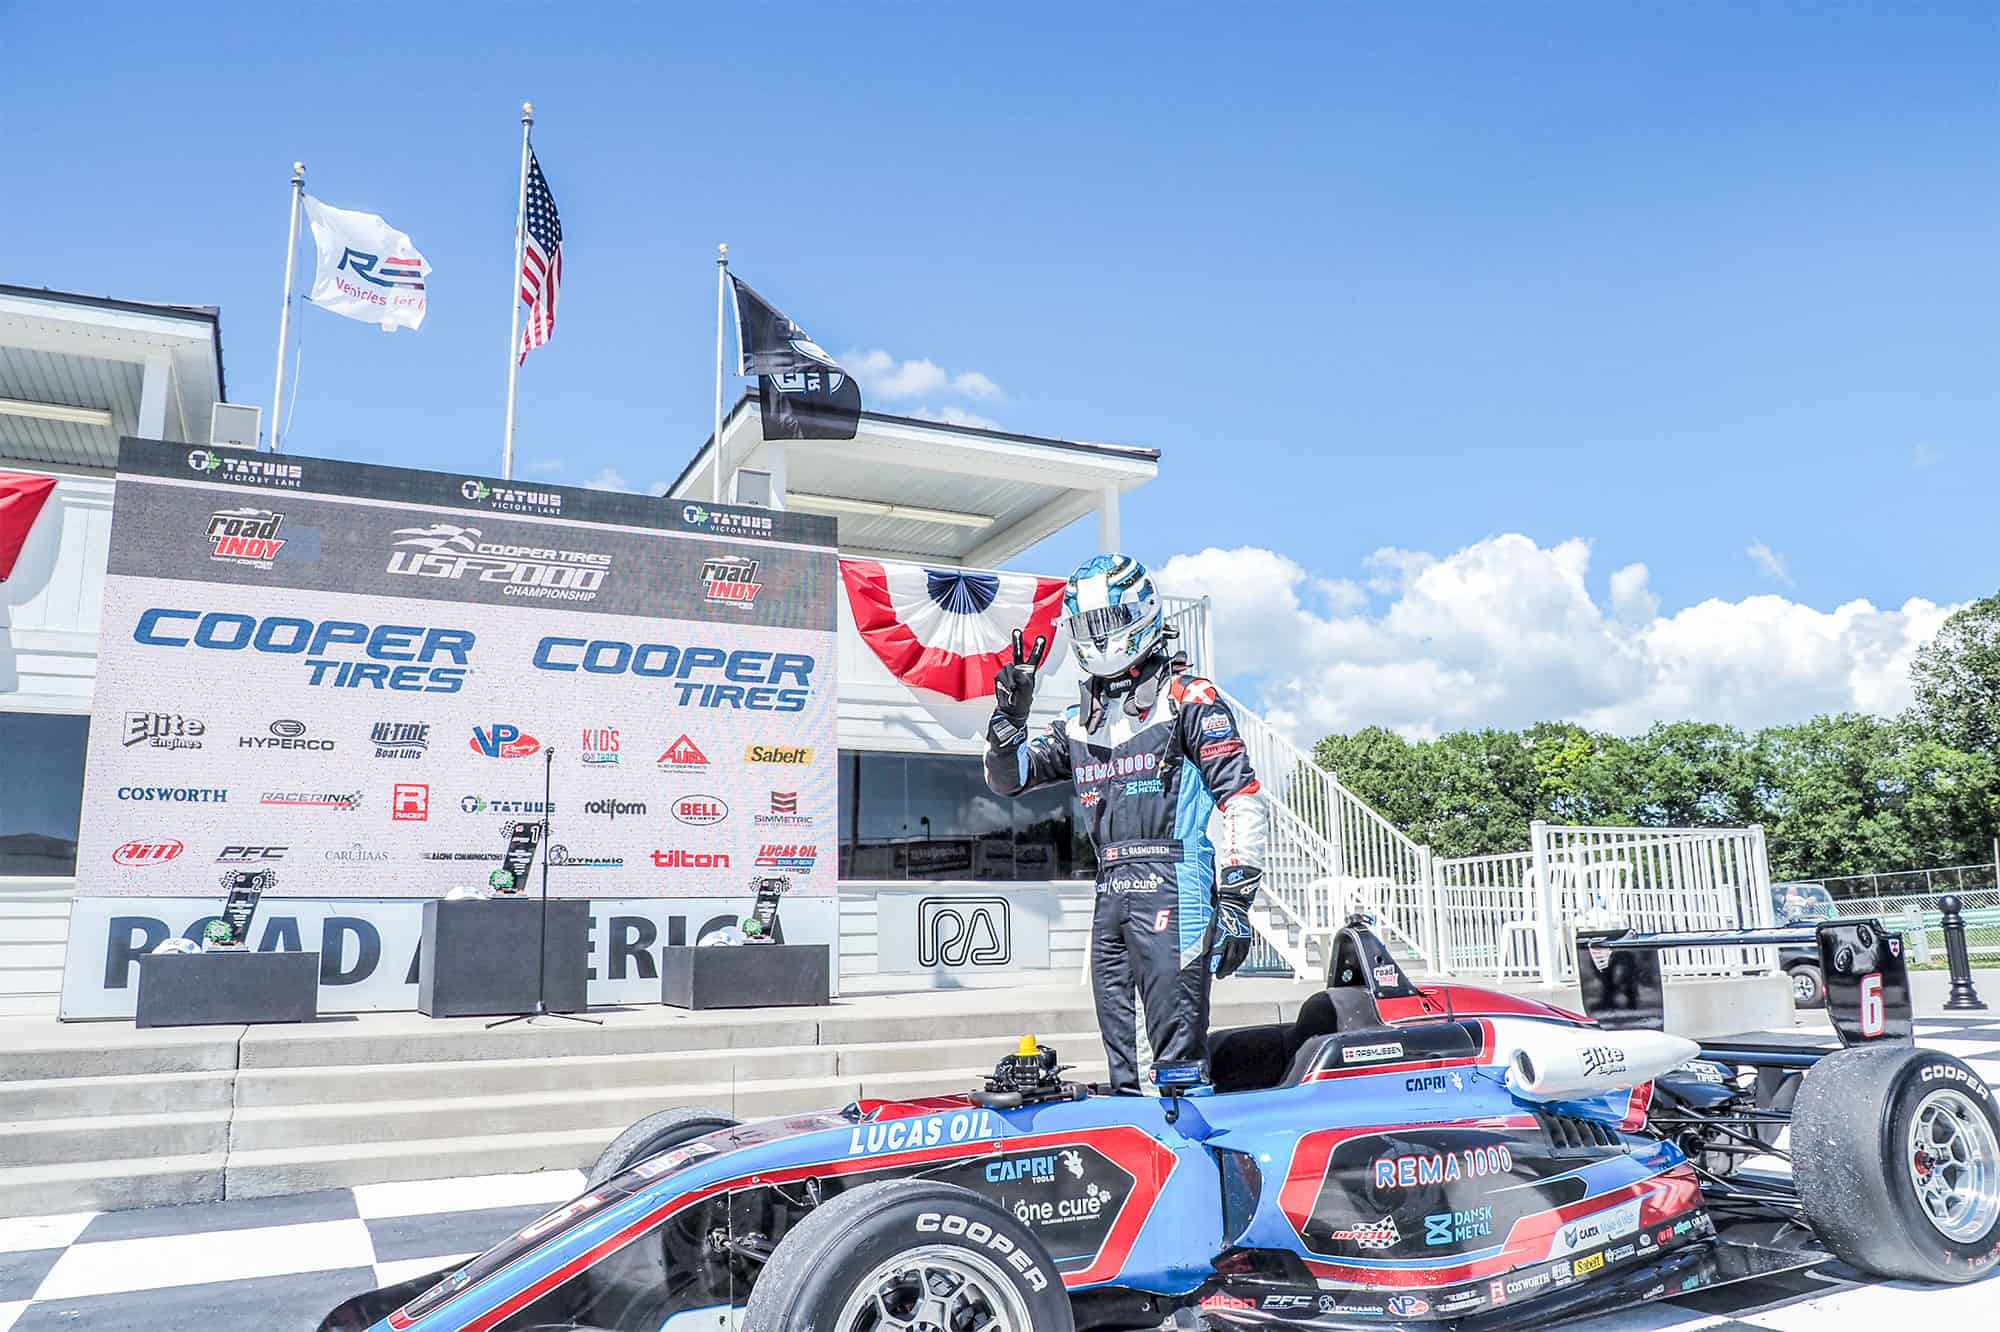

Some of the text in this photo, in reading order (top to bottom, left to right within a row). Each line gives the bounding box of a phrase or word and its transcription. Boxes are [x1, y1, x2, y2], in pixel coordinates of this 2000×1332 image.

[335, 276, 388, 306] Vehicles
[224, 457, 302, 479] TATUUS
[222, 472, 302, 488] VICTORY LANE
[492, 487, 562, 507] TATUUS
[491, 502, 561, 515] VICTORY LANE
[206, 514, 283, 539] road
[710, 512, 772, 530] TATUUS
[710, 525, 747, 536] VICTORY
[215, 535, 285, 559] INDY
[477, 543, 612, 565] COOPER TIRES
[386, 551, 604, 591] USF2000
[701, 561, 759, 582] road
[503, 585, 597, 602] CHAMPIONSHIP
[708, 581, 762, 601] INDY
[133, 607, 476, 665] COOPER
[532, 636, 816, 686] COOPER
[304, 659, 467, 694] TIRES
[674, 682, 810, 712] TIRES
[123, 711, 206, 748] Elite
[150, 736, 203, 750] Engines
[239, 737, 335, 750] HYPERCO
[472, 723, 520, 759] VP
[582, 729, 620, 752] KIDS
[375, 748, 422, 759] Boat Lifts
[751, 746, 808, 764] Sabelt
[1075, 753, 1155, 785] REMA 1000
[118, 786, 228, 803] COSWORTH
[491, 800, 556, 813] TATUUS
[584, 799, 647, 820] rotiform
[680, 803, 721, 817] BELL
[219, 846, 289, 858] PFC
[650, 850, 730, 868] tilton
[758, 845, 817, 857] LUCAS OIL
[251, 876, 263, 893] 2
[1133, 879, 1158, 889] cure
[1153, 909, 1170, 932] 6
[104, 916, 381, 989] RAD
[1861, 973, 1884, 1038] 6
[1577, 1046, 1625, 1077] Elite
[1406, 1075, 1446, 1092] CAPRI
[1920, 1064, 1989, 1101] COOPER
[848, 1110, 994, 1155] LUCAS OIL
[985, 1155, 1055, 1183] CAPRI
[1375, 1145, 1513, 1188] REMA 1000
[1032, 1175, 1055, 1184] TOOLS
[1015, 1202, 1053, 1222] one
[1058, 1196, 1101, 1217] cure
[1454, 1205, 1493, 1226] DANSK
[1454, 1225, 1493, 1242] METAL
[915, 1212, 1049, 1293] COOPER
[1506, 1273, 1551, 1294] COSWORTH
[1264, 1295, 1313, 1306] PFC
[1390, 1296, 1416, 1314] VP
